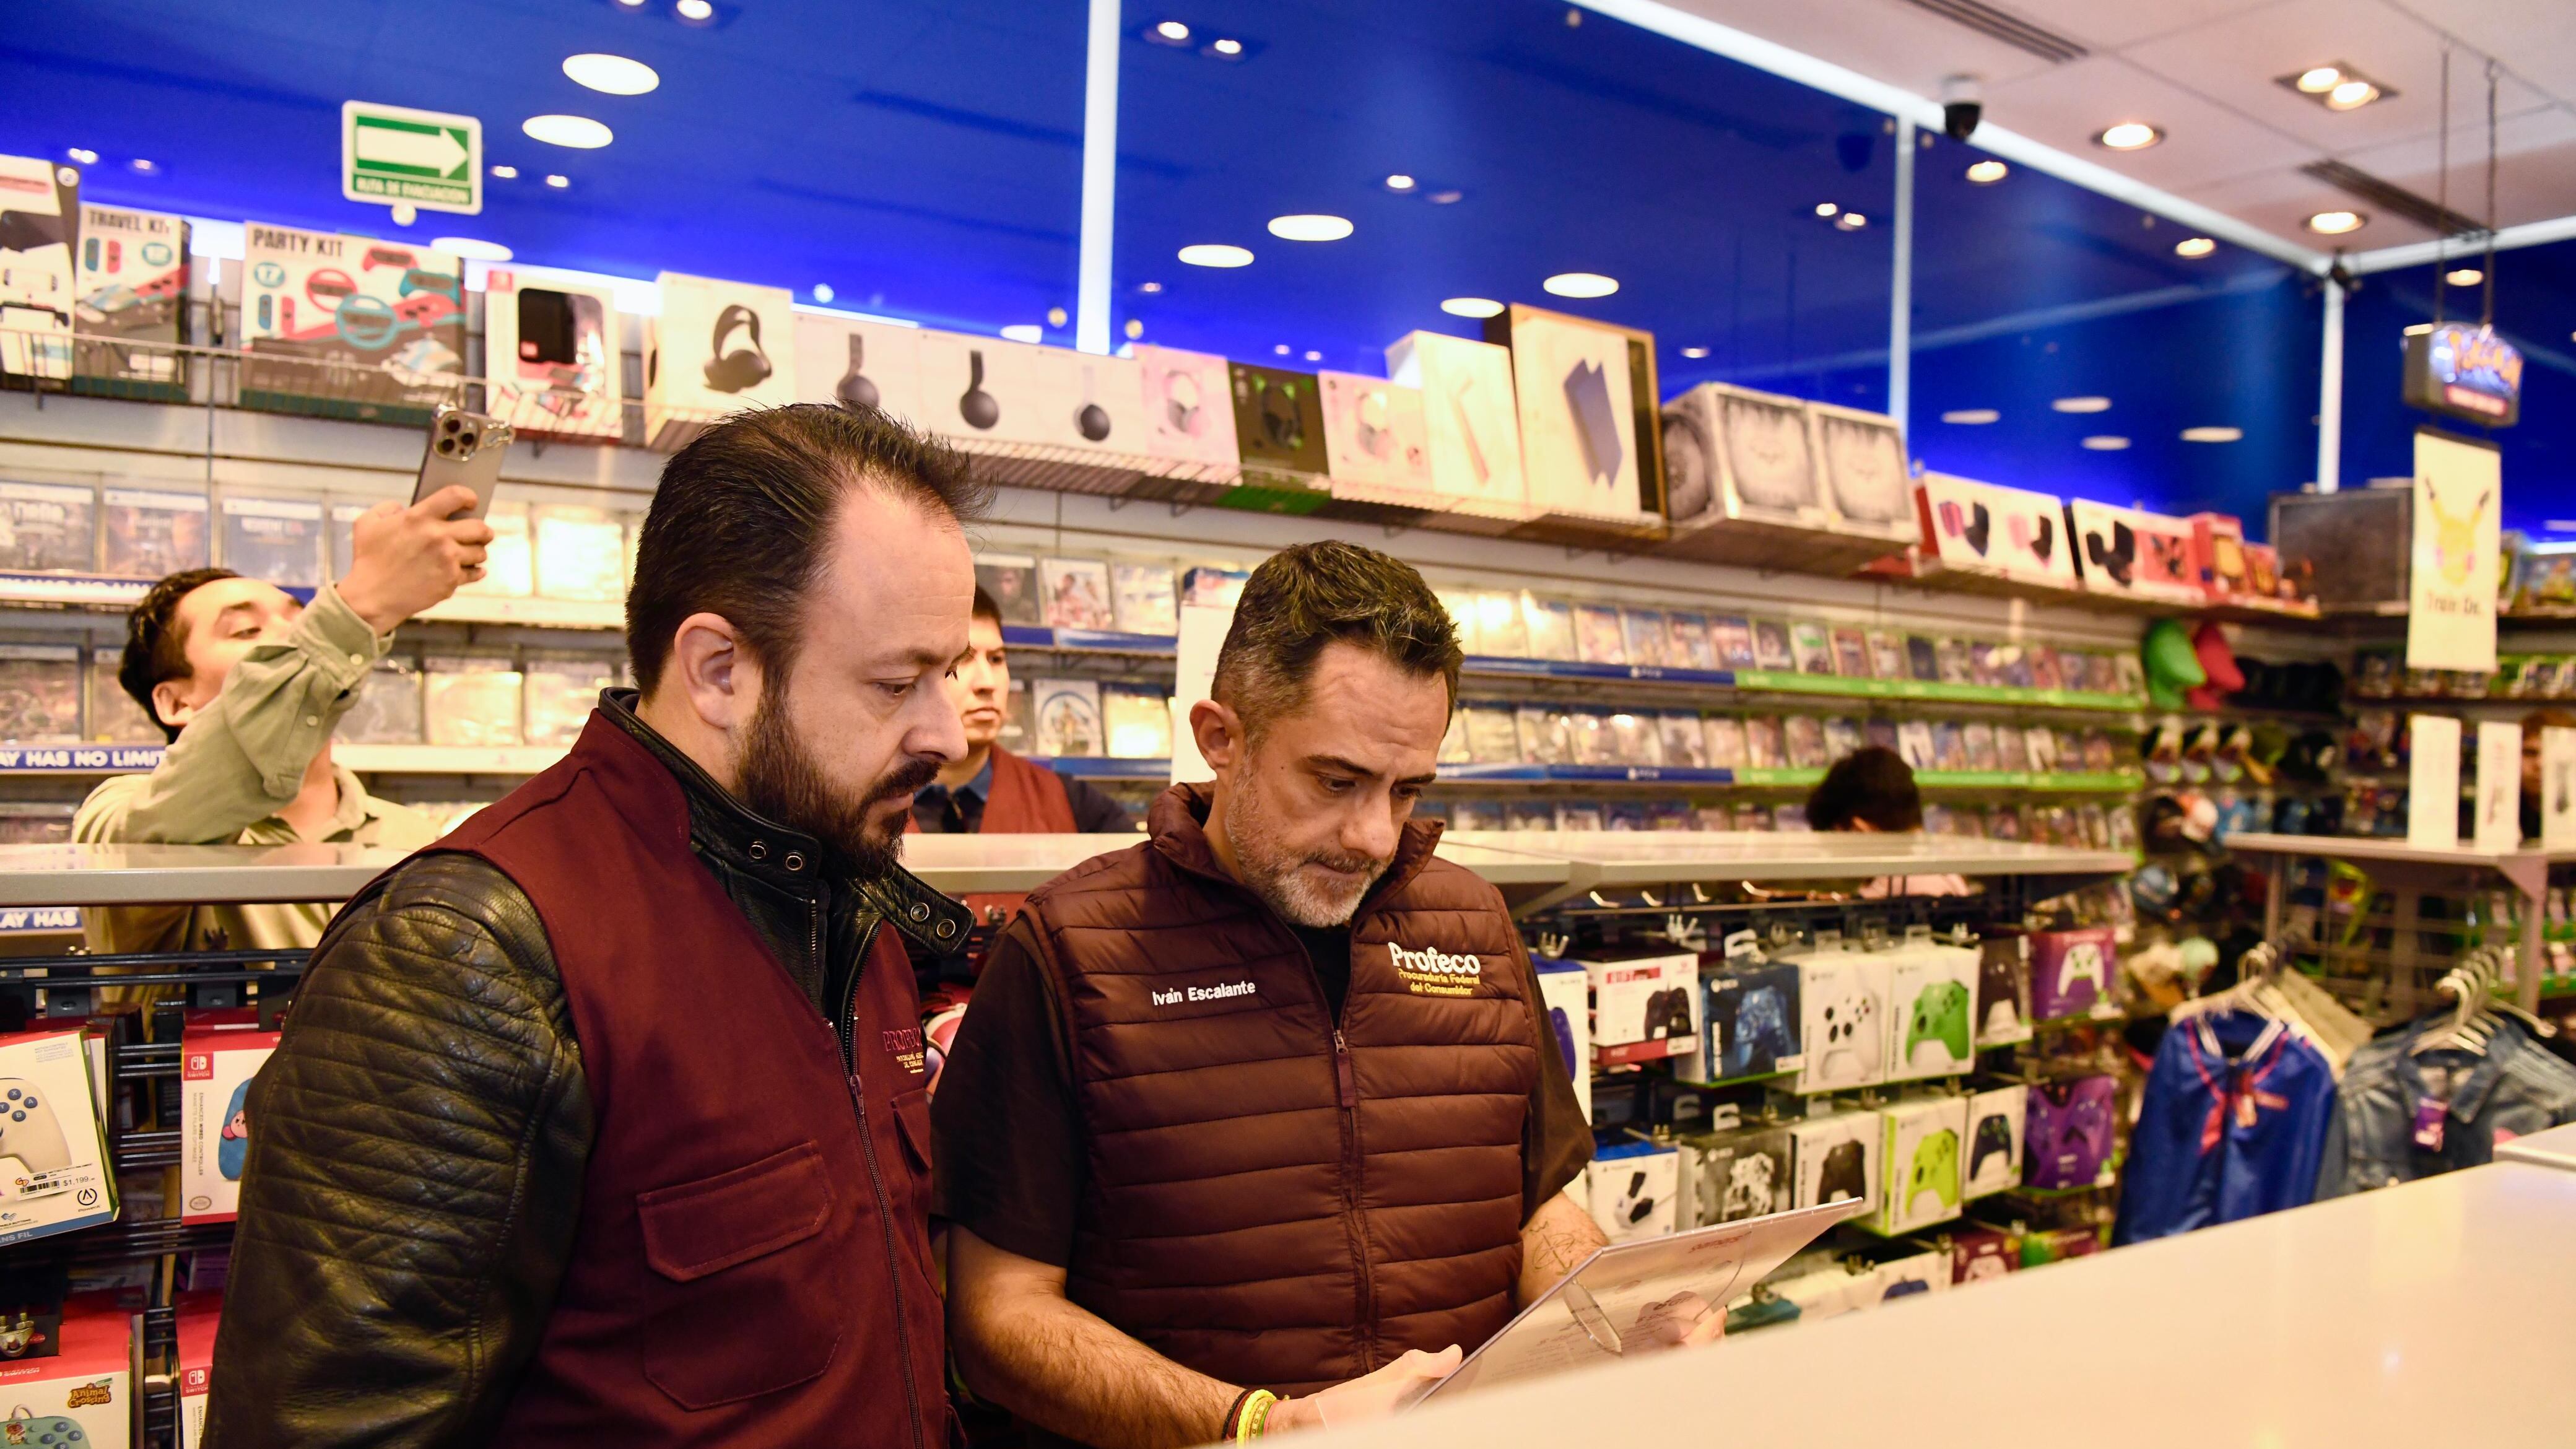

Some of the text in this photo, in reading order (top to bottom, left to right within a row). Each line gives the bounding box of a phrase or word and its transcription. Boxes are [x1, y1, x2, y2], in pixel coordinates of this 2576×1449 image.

[89, 209, 142, 232] TRAVEL
[253, 228, 342, 257] PARTY KIT
[26, 750, 71, 767] HAS
[74, 750, 109, 767] NO
[33, 910, 78, 928] HAS
[1388, 941, 1481, 975] Profeco
[1449, 973, 1481, 985] Federal
[1152, 980, 1256, 1006] Iván Escalante
[1410, 981, 1473, 996] del Consumidor
[17, 1230, 33, 1240] FIL
[69, 1393, 110, 1408] Crossing
[71, 1386, 108, 1398] Animal
